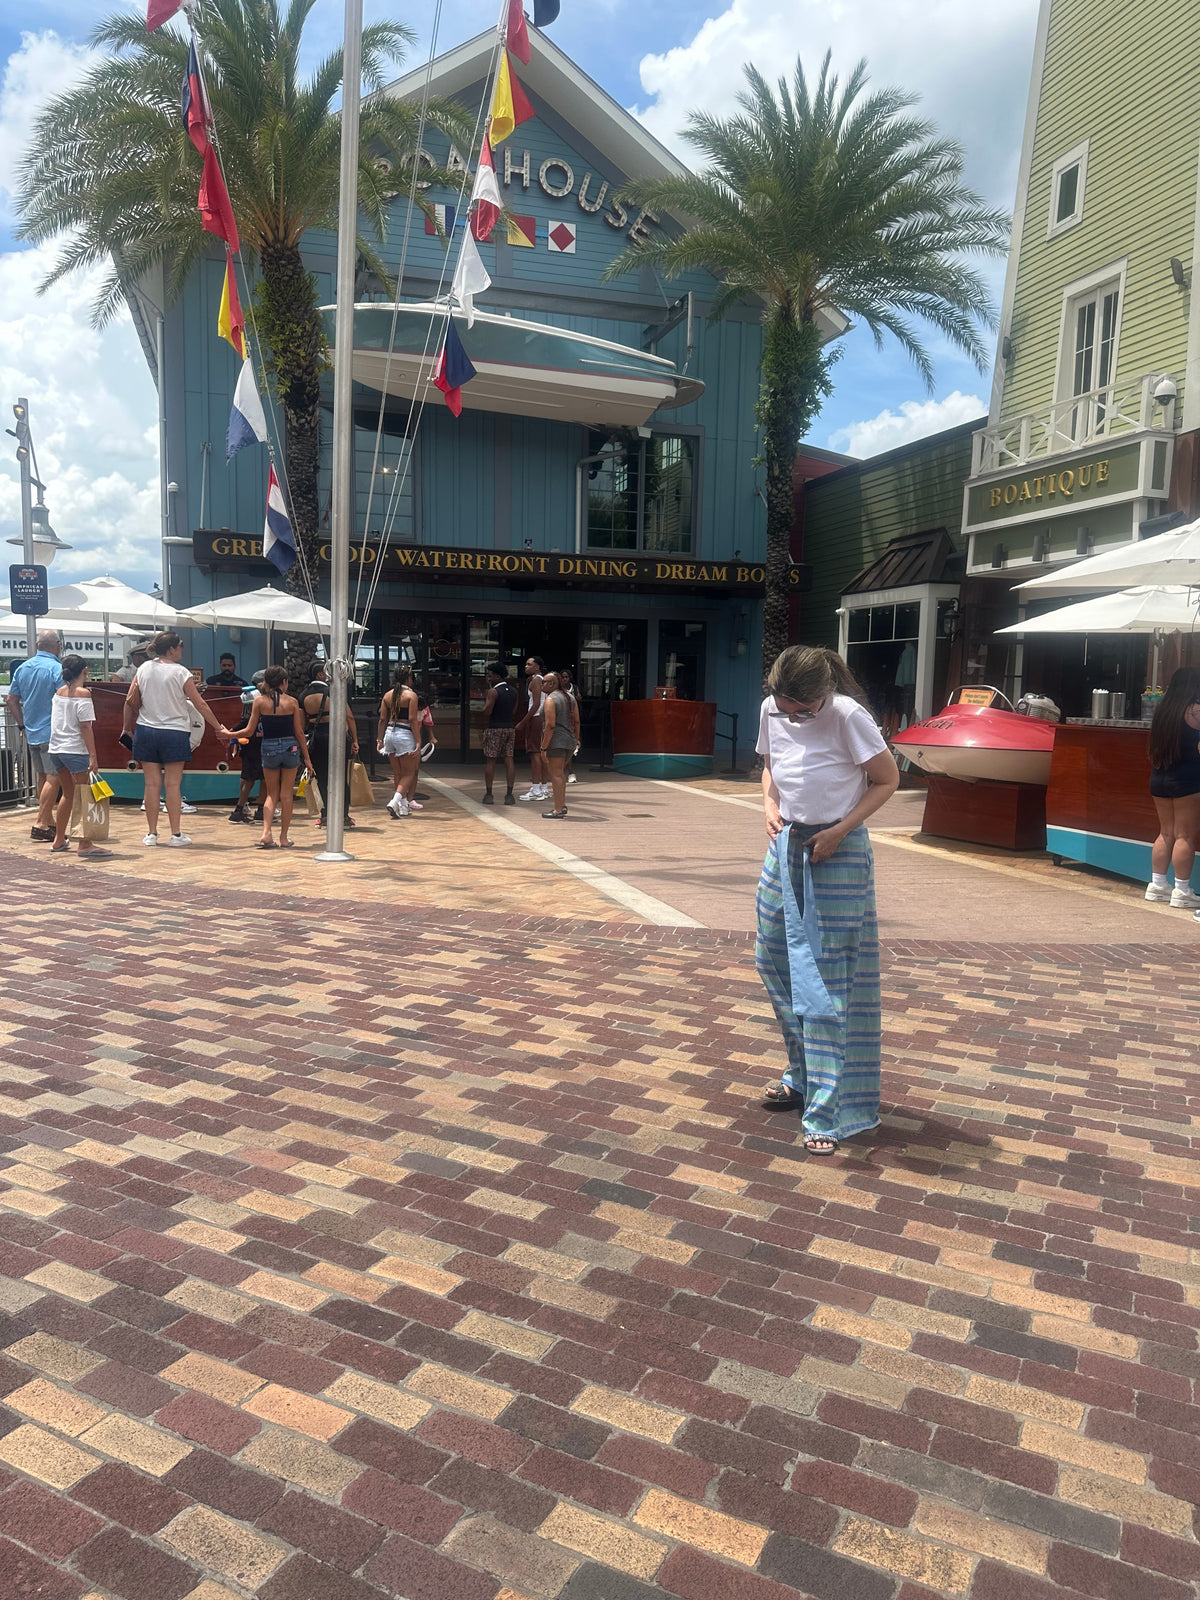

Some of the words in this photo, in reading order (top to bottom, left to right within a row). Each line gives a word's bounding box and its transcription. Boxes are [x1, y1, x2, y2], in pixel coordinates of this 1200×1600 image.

[373, 144, 661, 245] OAHOUSE
[990, 460, 1110, 507] BOATIQUE
[211, 537, 263, 557] GRE
[394, 549, 550, 574] WATERFRONT
[558, 558, 638, 577] DINING
[655, 563, 728, 582] DREAM
[735, 567, 800, 584] BOS
[64, 641, 114, 651] AUNCH
[85, 800, 105, 825] 50
